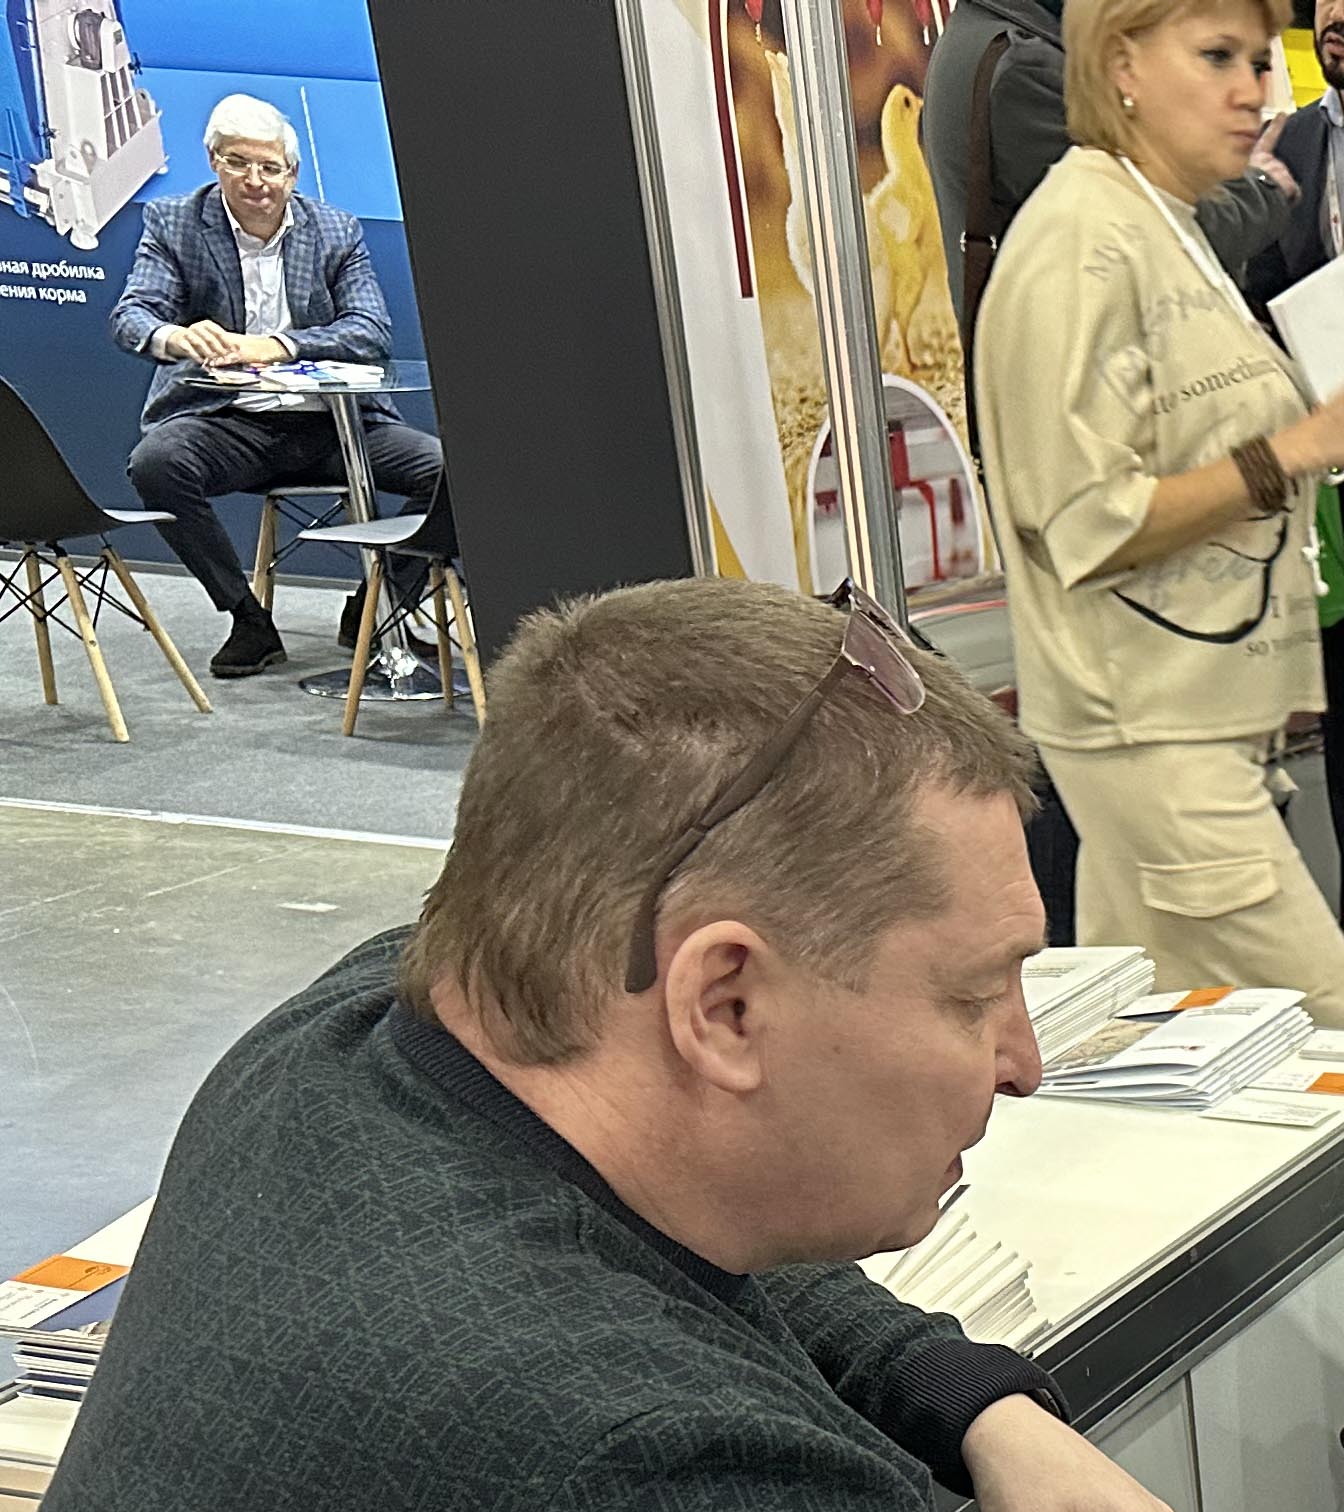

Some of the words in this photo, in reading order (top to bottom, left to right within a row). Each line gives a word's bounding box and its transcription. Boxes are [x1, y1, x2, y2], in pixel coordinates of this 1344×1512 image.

[31, 260, 105, 280] дробилка
[0, 284, 37, 300] ения
[38, 287, 87, 305] корма
